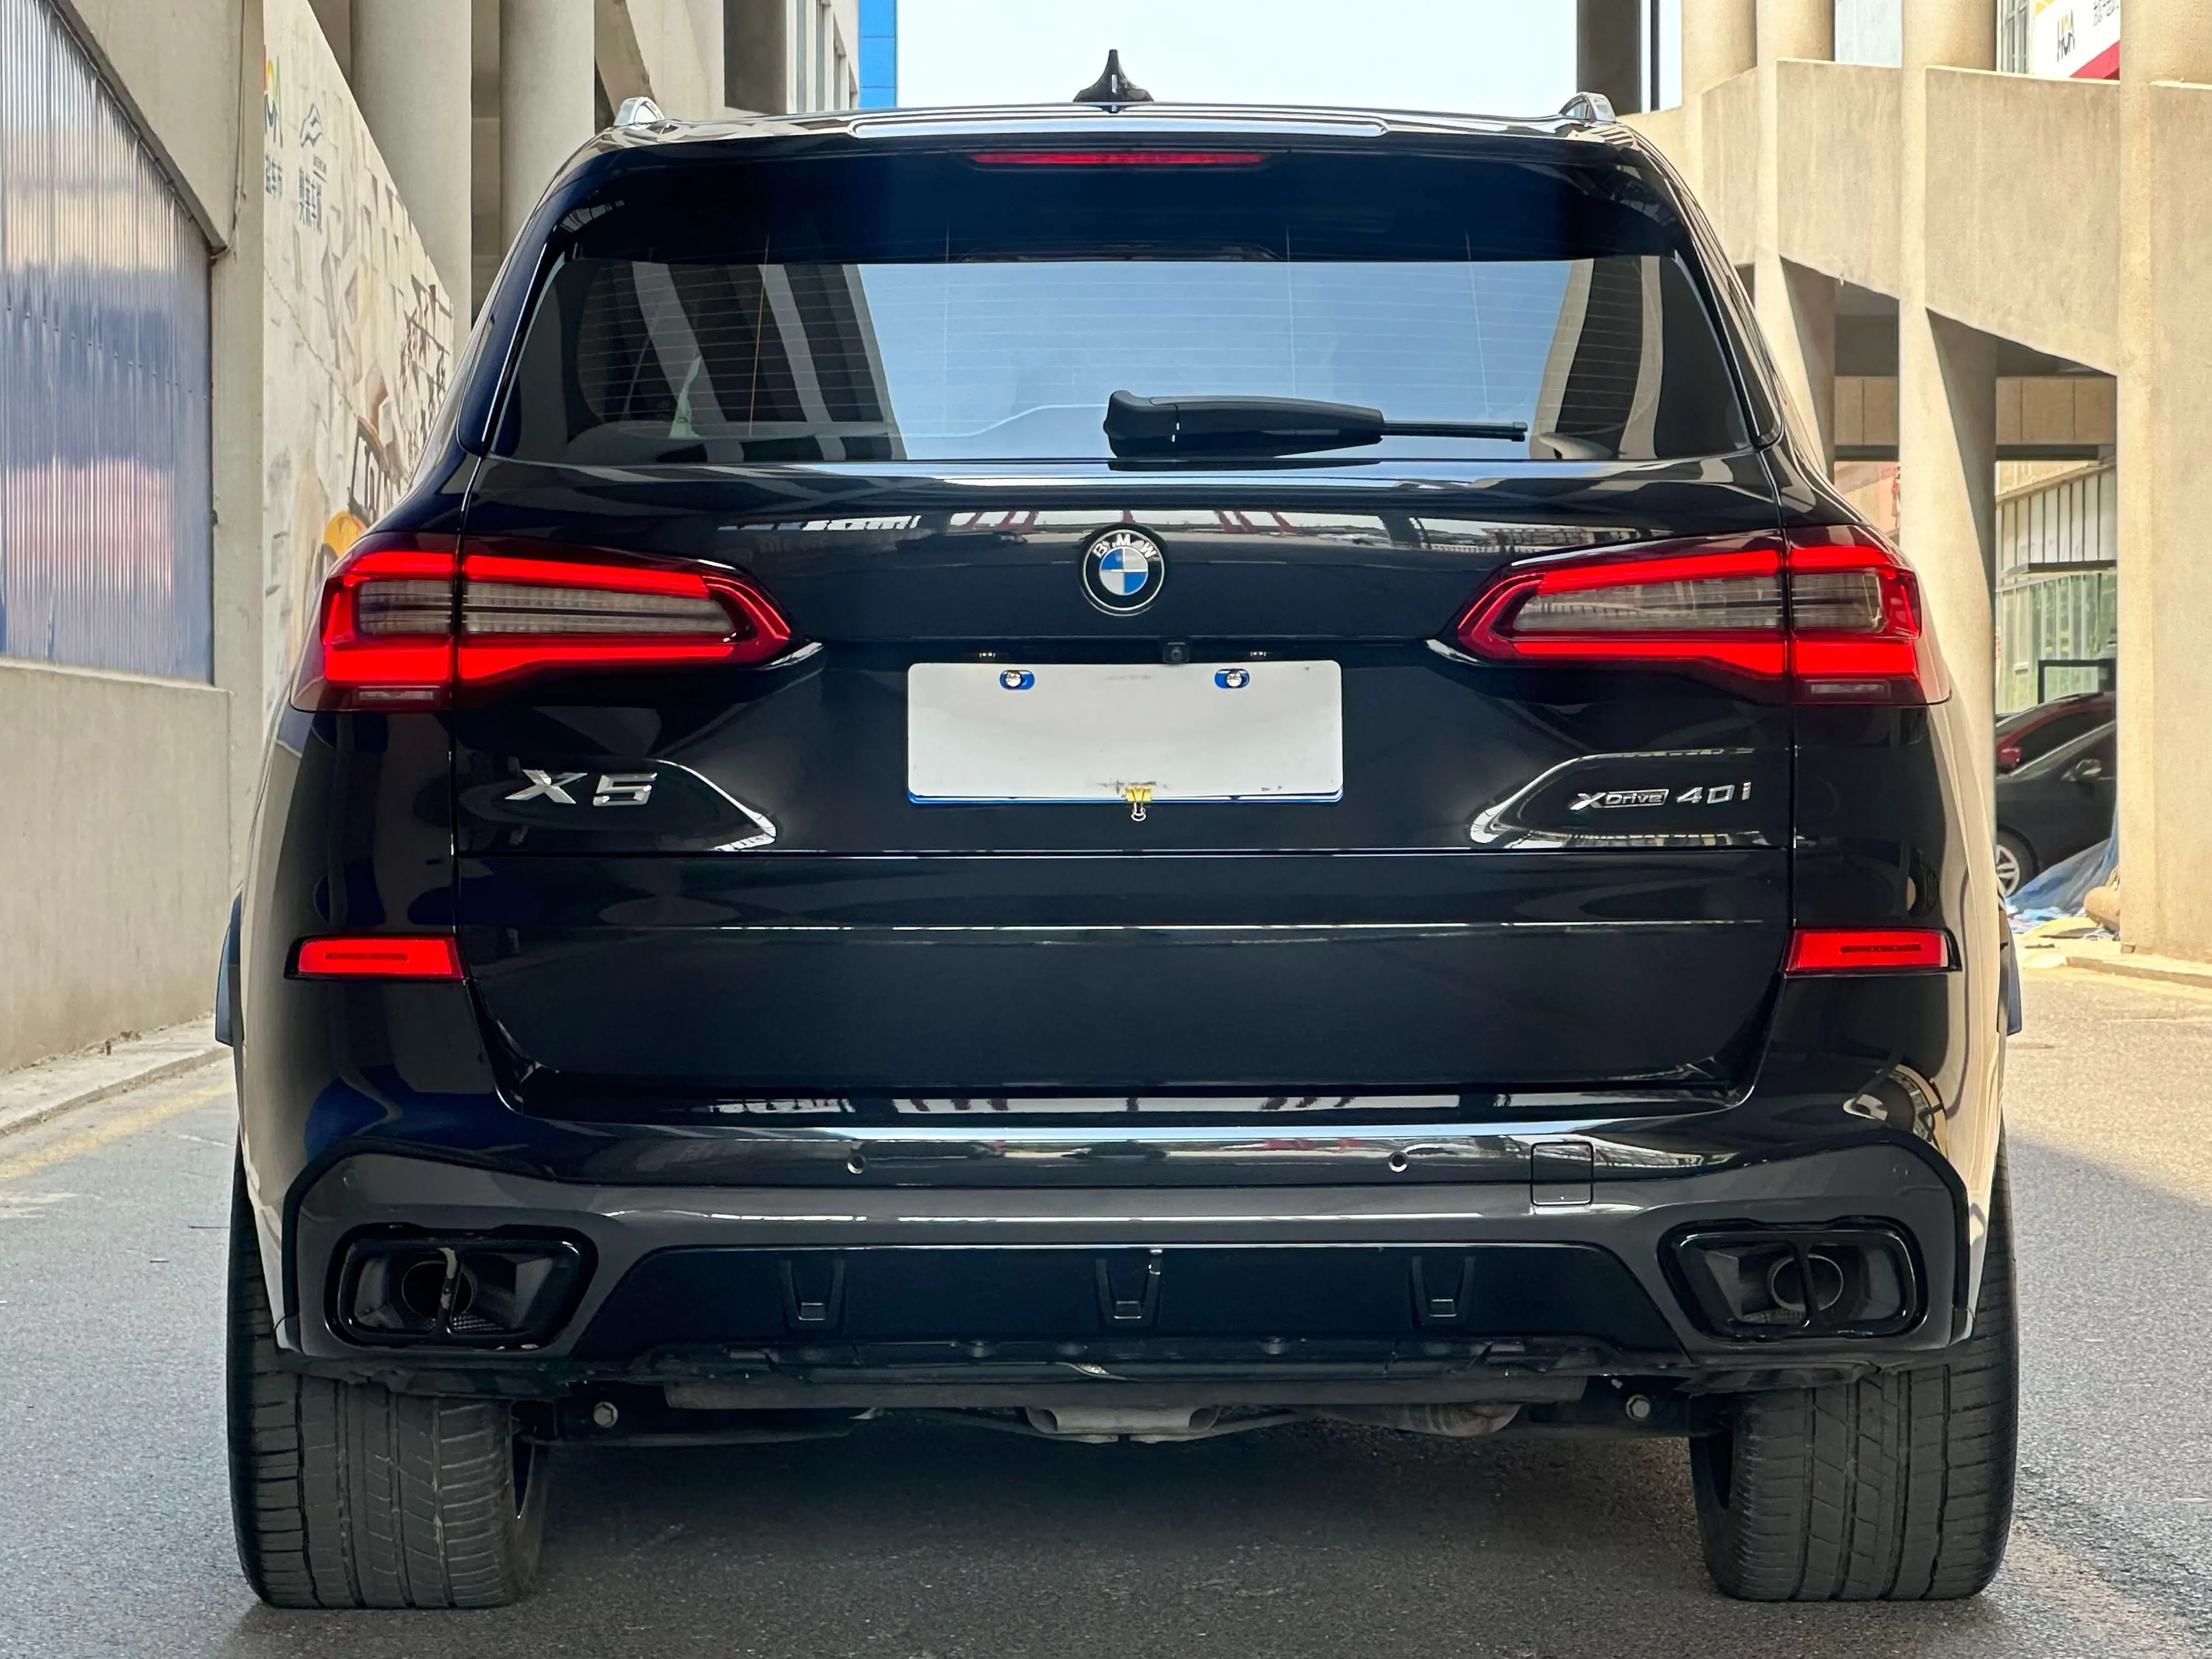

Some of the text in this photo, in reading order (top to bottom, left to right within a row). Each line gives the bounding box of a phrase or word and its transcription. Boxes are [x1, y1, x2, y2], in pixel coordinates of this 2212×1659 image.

[1092, 533, 1157, 558] BMW
[505, 769, 658, 806] X5
[1677, 781, 1751, 804] 40i
